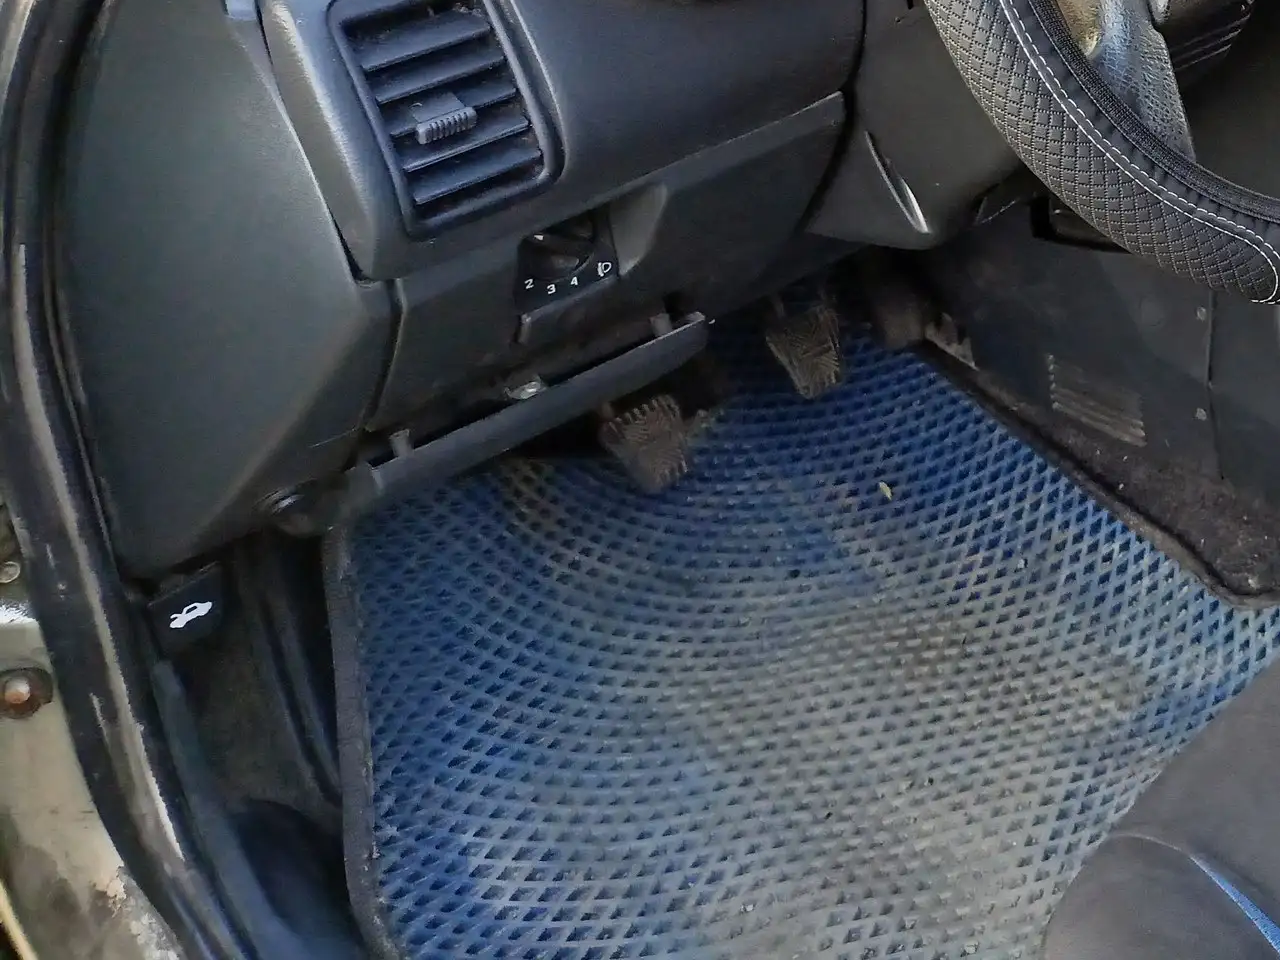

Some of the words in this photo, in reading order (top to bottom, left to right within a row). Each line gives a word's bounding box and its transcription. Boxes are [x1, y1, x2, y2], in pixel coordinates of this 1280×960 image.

[524, 278, 535, 290] 2
[546, 283, 557, 295] 3
[570, 276, 579, 286] 4
